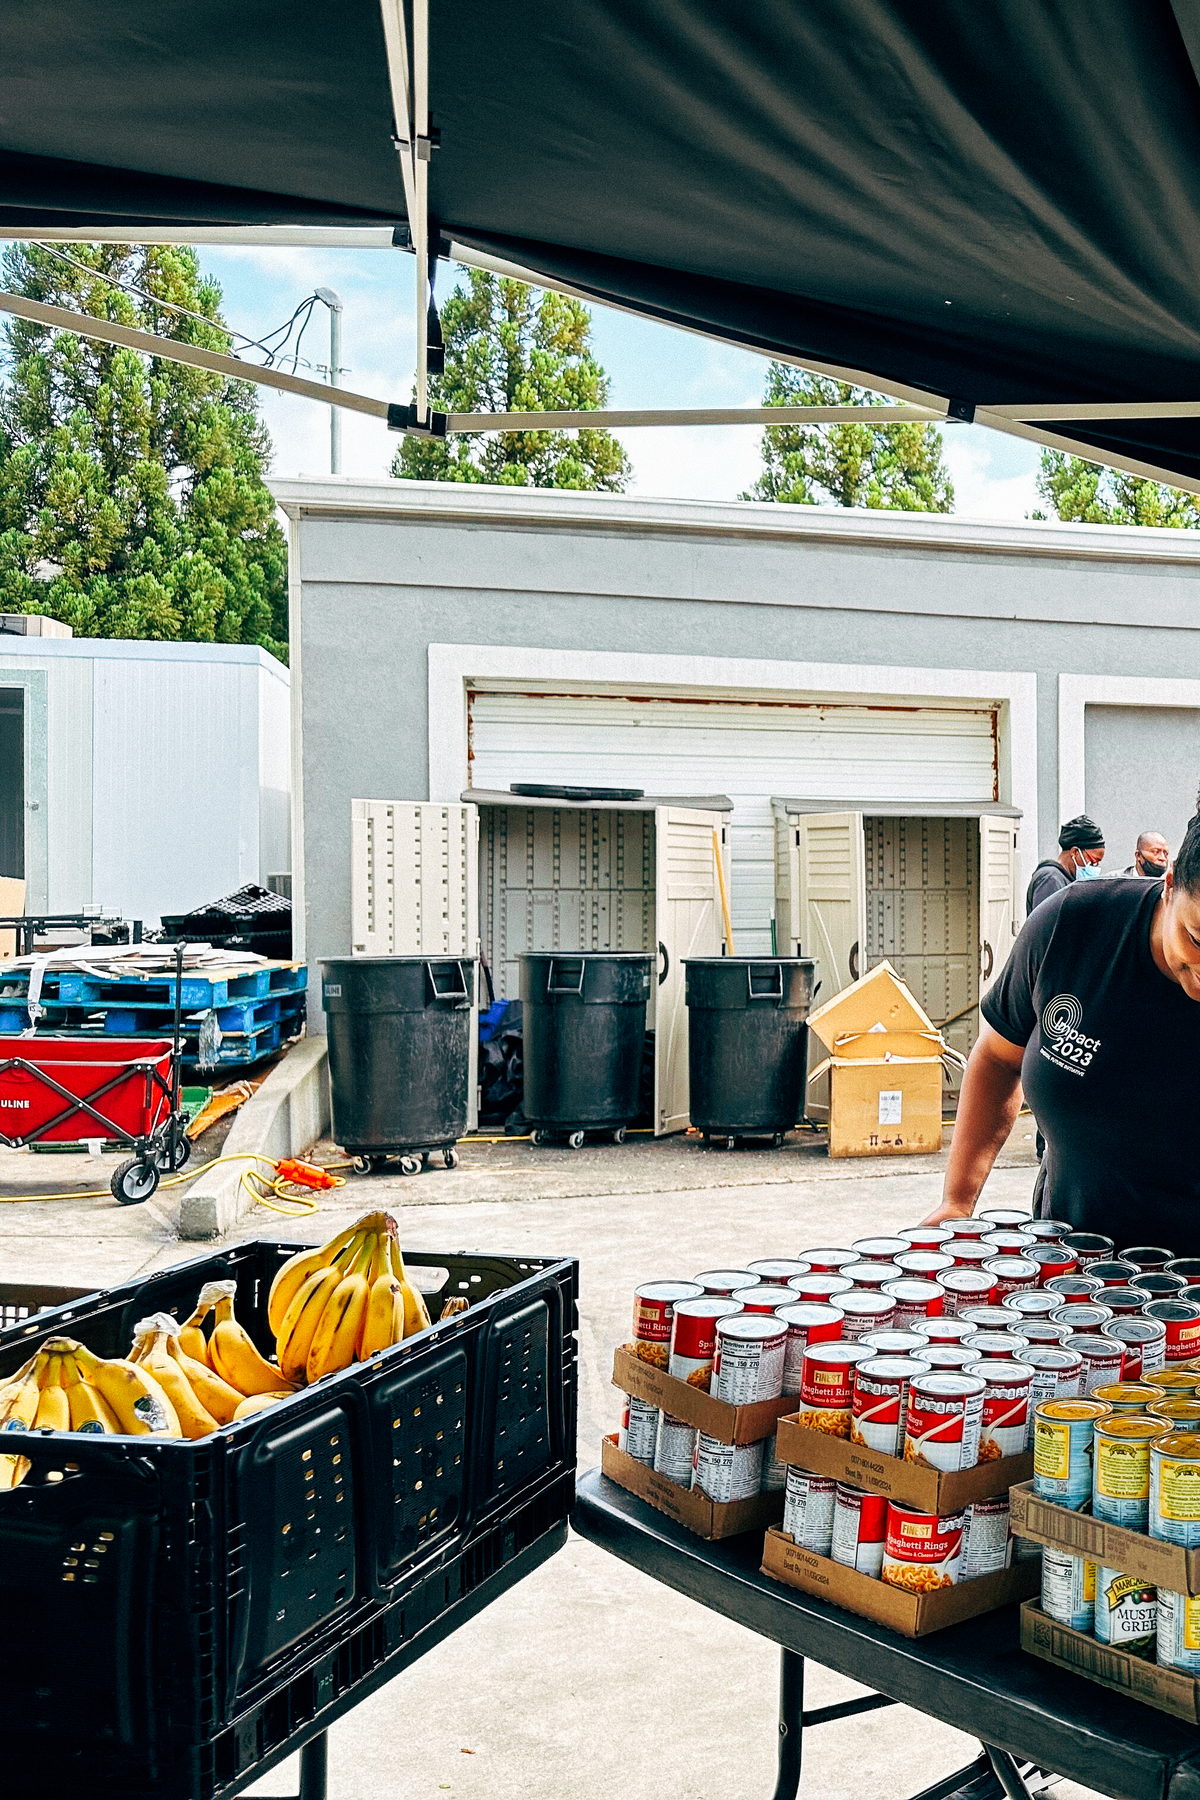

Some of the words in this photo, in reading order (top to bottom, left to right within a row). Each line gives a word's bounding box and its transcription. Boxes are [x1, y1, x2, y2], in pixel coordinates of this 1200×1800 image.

[1054, 1016, 1101, 1052] Impact
[1051, 1037, 1093, 1067] 2023
[0, 1099, 30, 1109] ULINE
[737, 1359, 747, 1368] 150
[749, 1360, 760, 1368] 270
[815, 1371, 842, 1384] FINEST
[722, 1458, 733, 1466] 270
[902, 1523, 930, 1537] FINEST
[923, 1540, 948, 1552] Rings
[1064, 1568, 1072, 1577] 20
